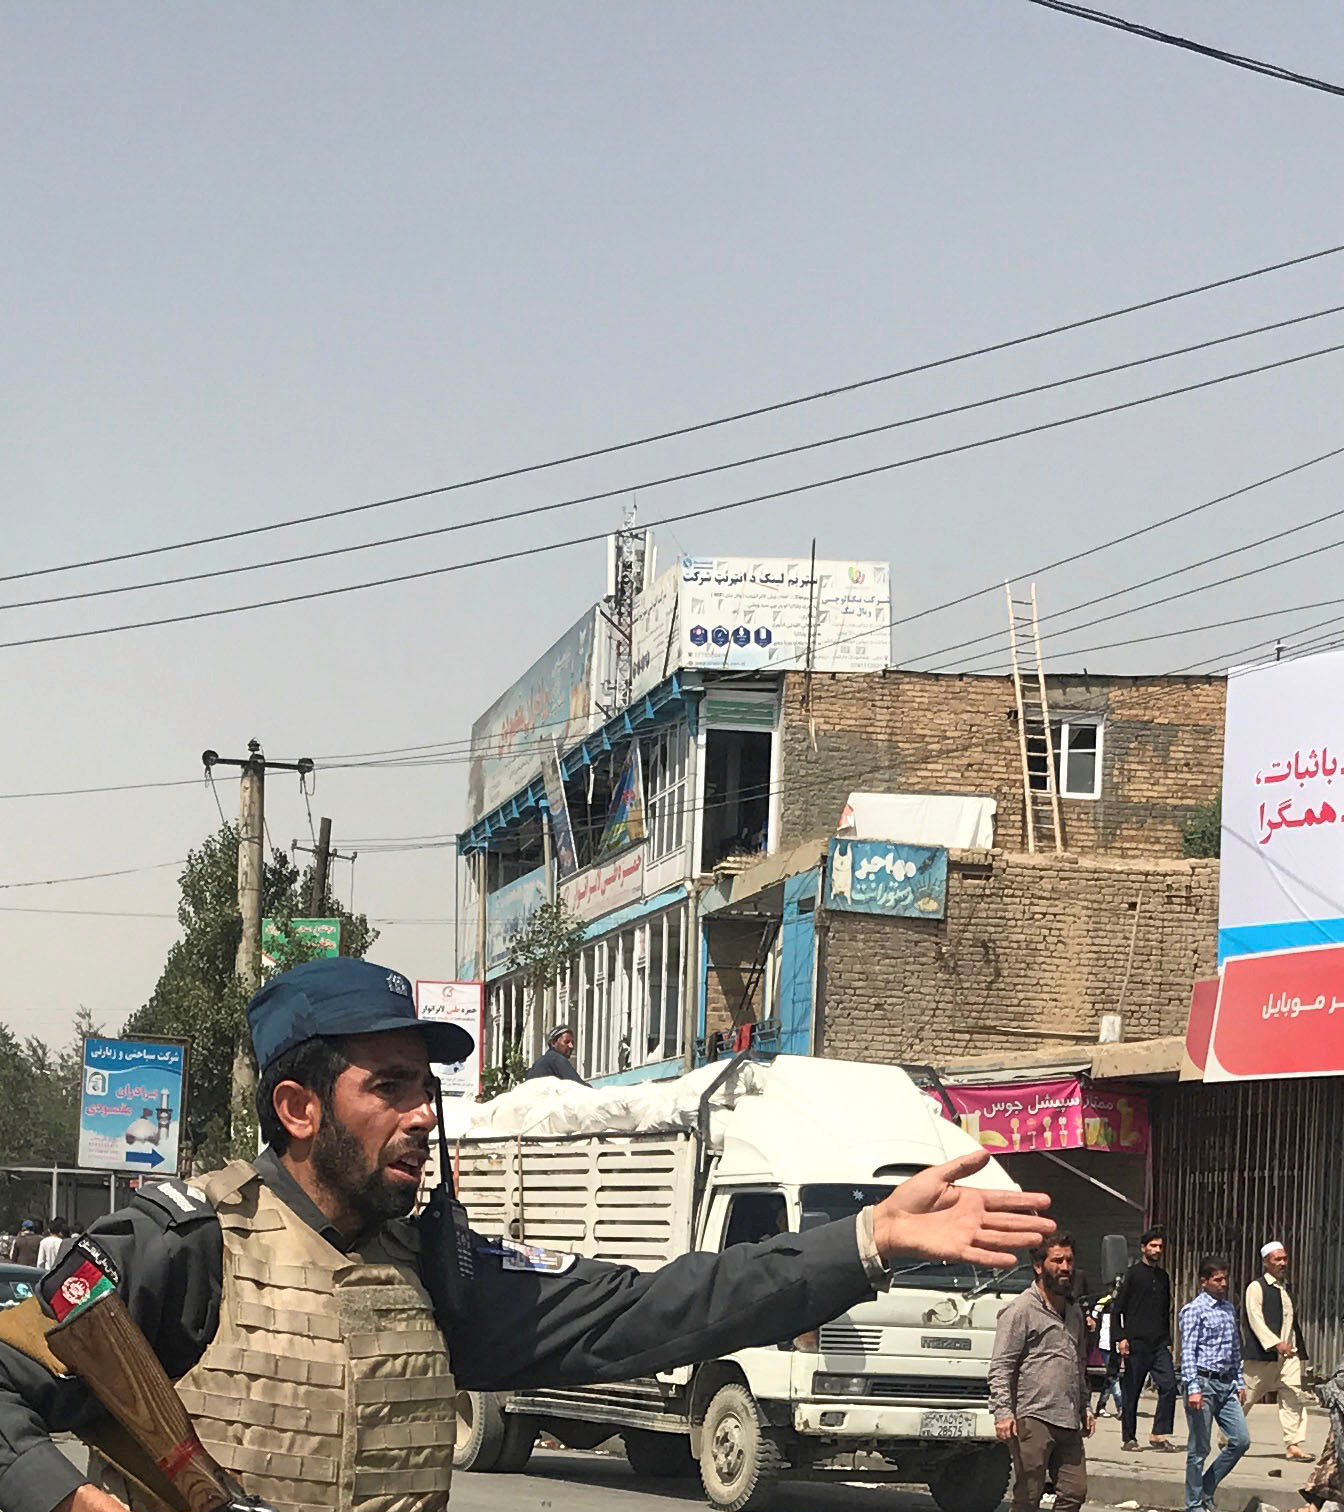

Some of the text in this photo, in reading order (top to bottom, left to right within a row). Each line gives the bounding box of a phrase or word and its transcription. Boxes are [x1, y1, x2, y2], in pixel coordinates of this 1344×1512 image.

[1258, 798, 1337, 845] همگرا
[854, 851, 917, 882] مهاجر
[1261, 990, 1326, 1020] موبایل
[157, 1051, 179, 1065] شرکت
[983, 1099, 1023, 1118] جوس
[1027, 1093, 1080, 1115] سپیشل
